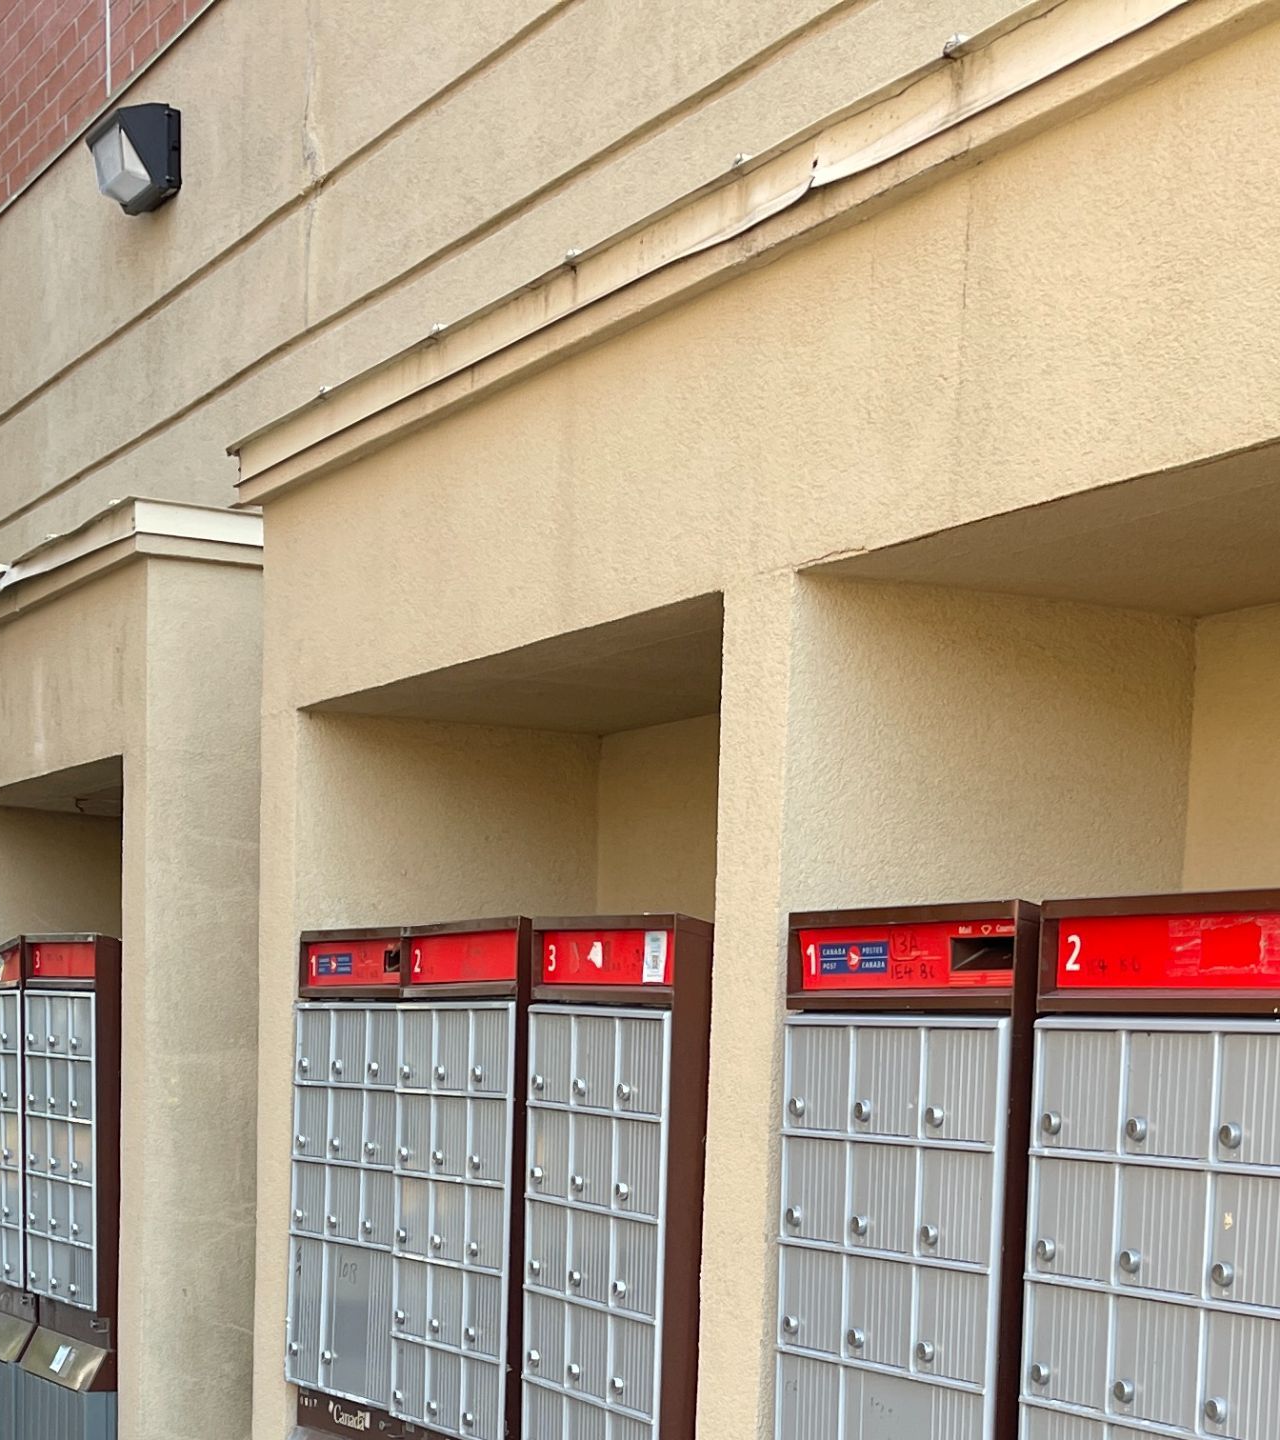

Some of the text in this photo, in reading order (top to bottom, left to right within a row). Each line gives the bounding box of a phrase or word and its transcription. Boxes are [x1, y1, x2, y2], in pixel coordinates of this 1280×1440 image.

[413, 949, 421, 973] 2
[548, 944, 556, 972] 3
[806, 944, 816, 976] 1
[822, 946, 883, 956] CANADA POSTES
[1065, 934, 1081, 971] 2
[310, 955, 316, 977] 1
[822, 961, 885, 970] POST CANADA
[333, 1404, 365, 1431] Canada
